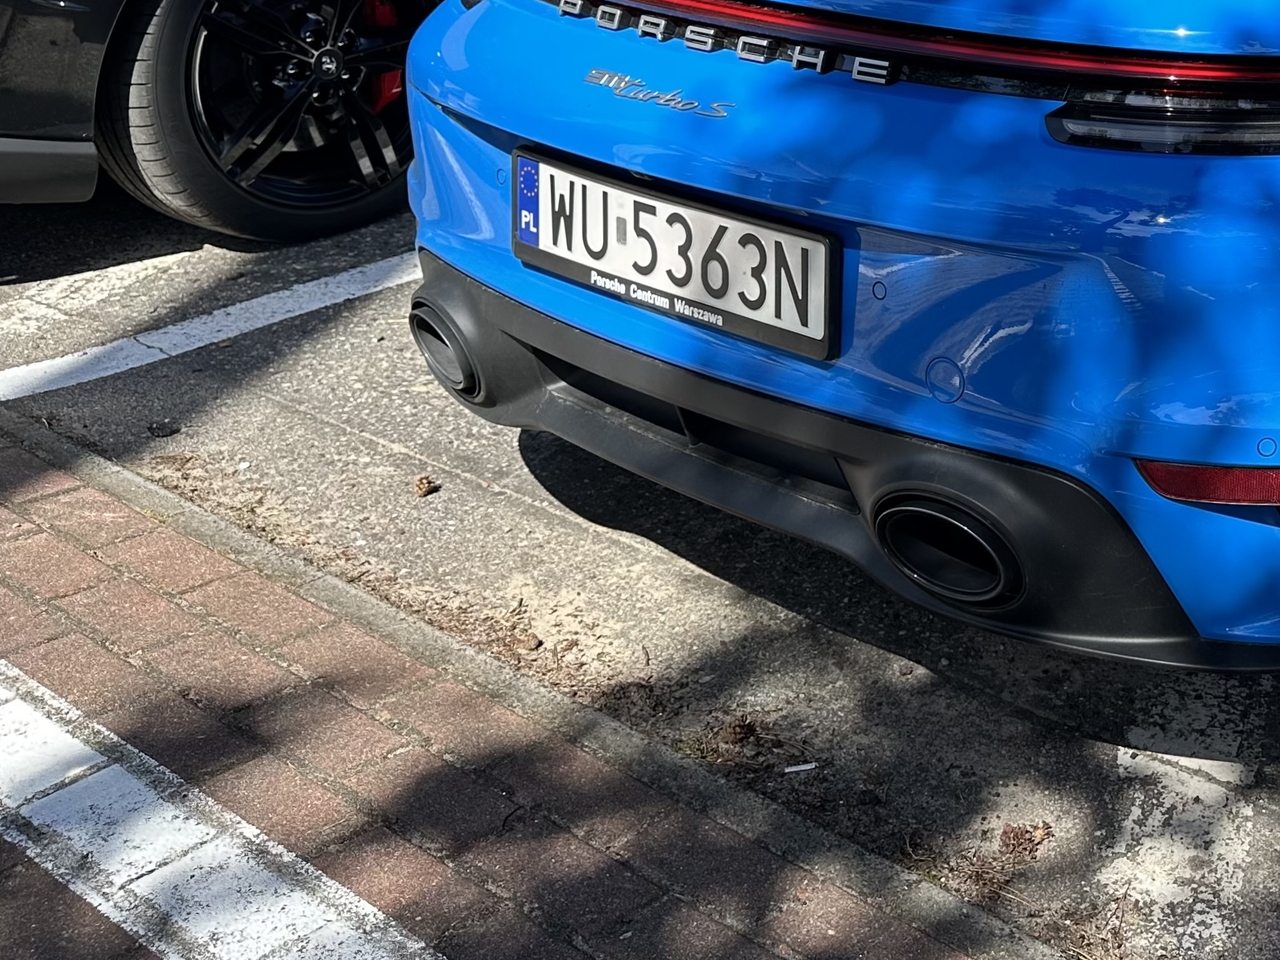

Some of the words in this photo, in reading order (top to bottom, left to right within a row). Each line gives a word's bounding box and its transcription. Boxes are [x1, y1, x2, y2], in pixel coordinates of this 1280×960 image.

[694, 101, 737, 118] S
[521, 209, 538, 234] PL
[550, 174, 609, 261] WU
[631, 199, 810, 329] 5363N
[590, 270, 626, 295] Porsche
[629, 284, 670, 310] Centrum
[673, 298, 724, 327] Warszawa
